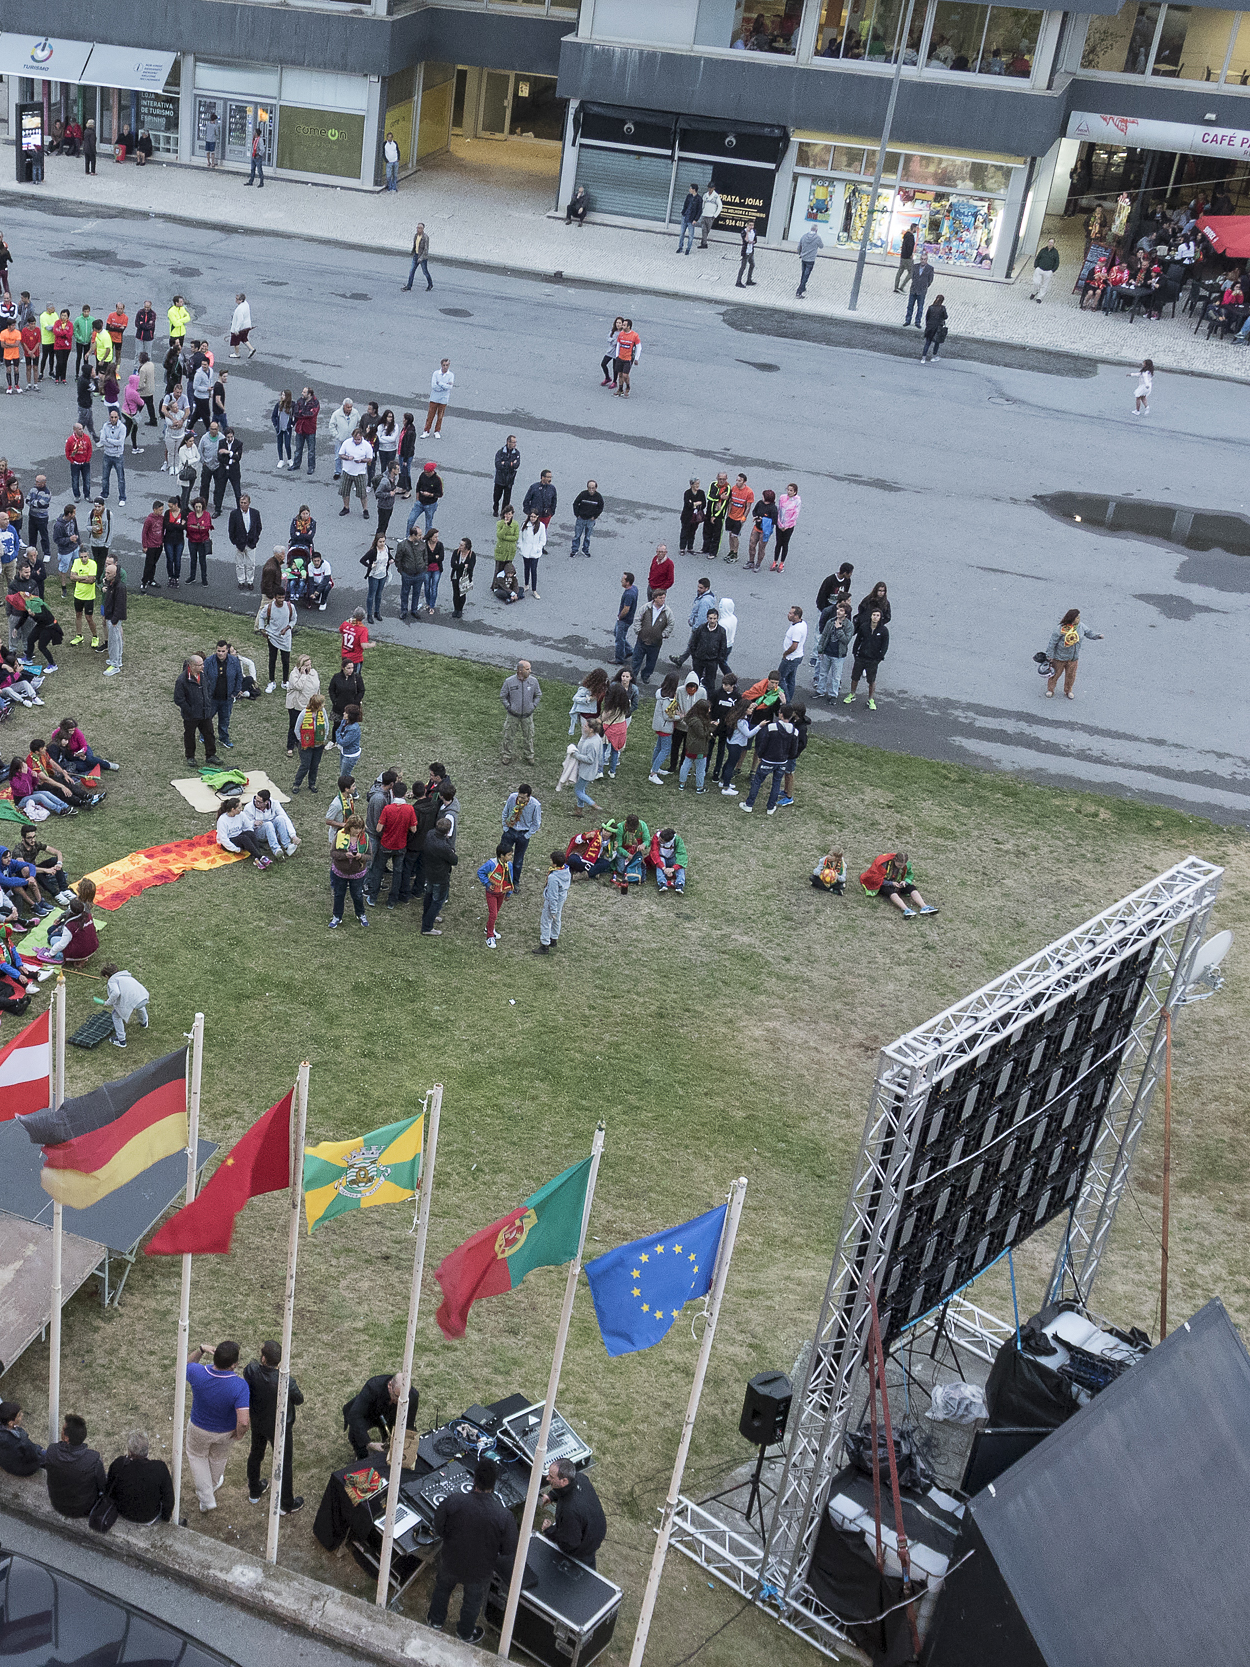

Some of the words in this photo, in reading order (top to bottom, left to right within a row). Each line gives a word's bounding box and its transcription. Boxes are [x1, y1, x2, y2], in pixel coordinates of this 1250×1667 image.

[23, 64, 50, 72] TURISMO
[140, 100, 173, 109] INTERATIVA
[150, 108, 174, 117] TURISMO
[141, 115, 166, 124] ESPINHO
[1202, 132, 1236, 147] CAFÉ
[719, 194, 740, 203] PRATA
[745, 198, 763, 206] JOIAS
[343, 633, 355, 649] 12
